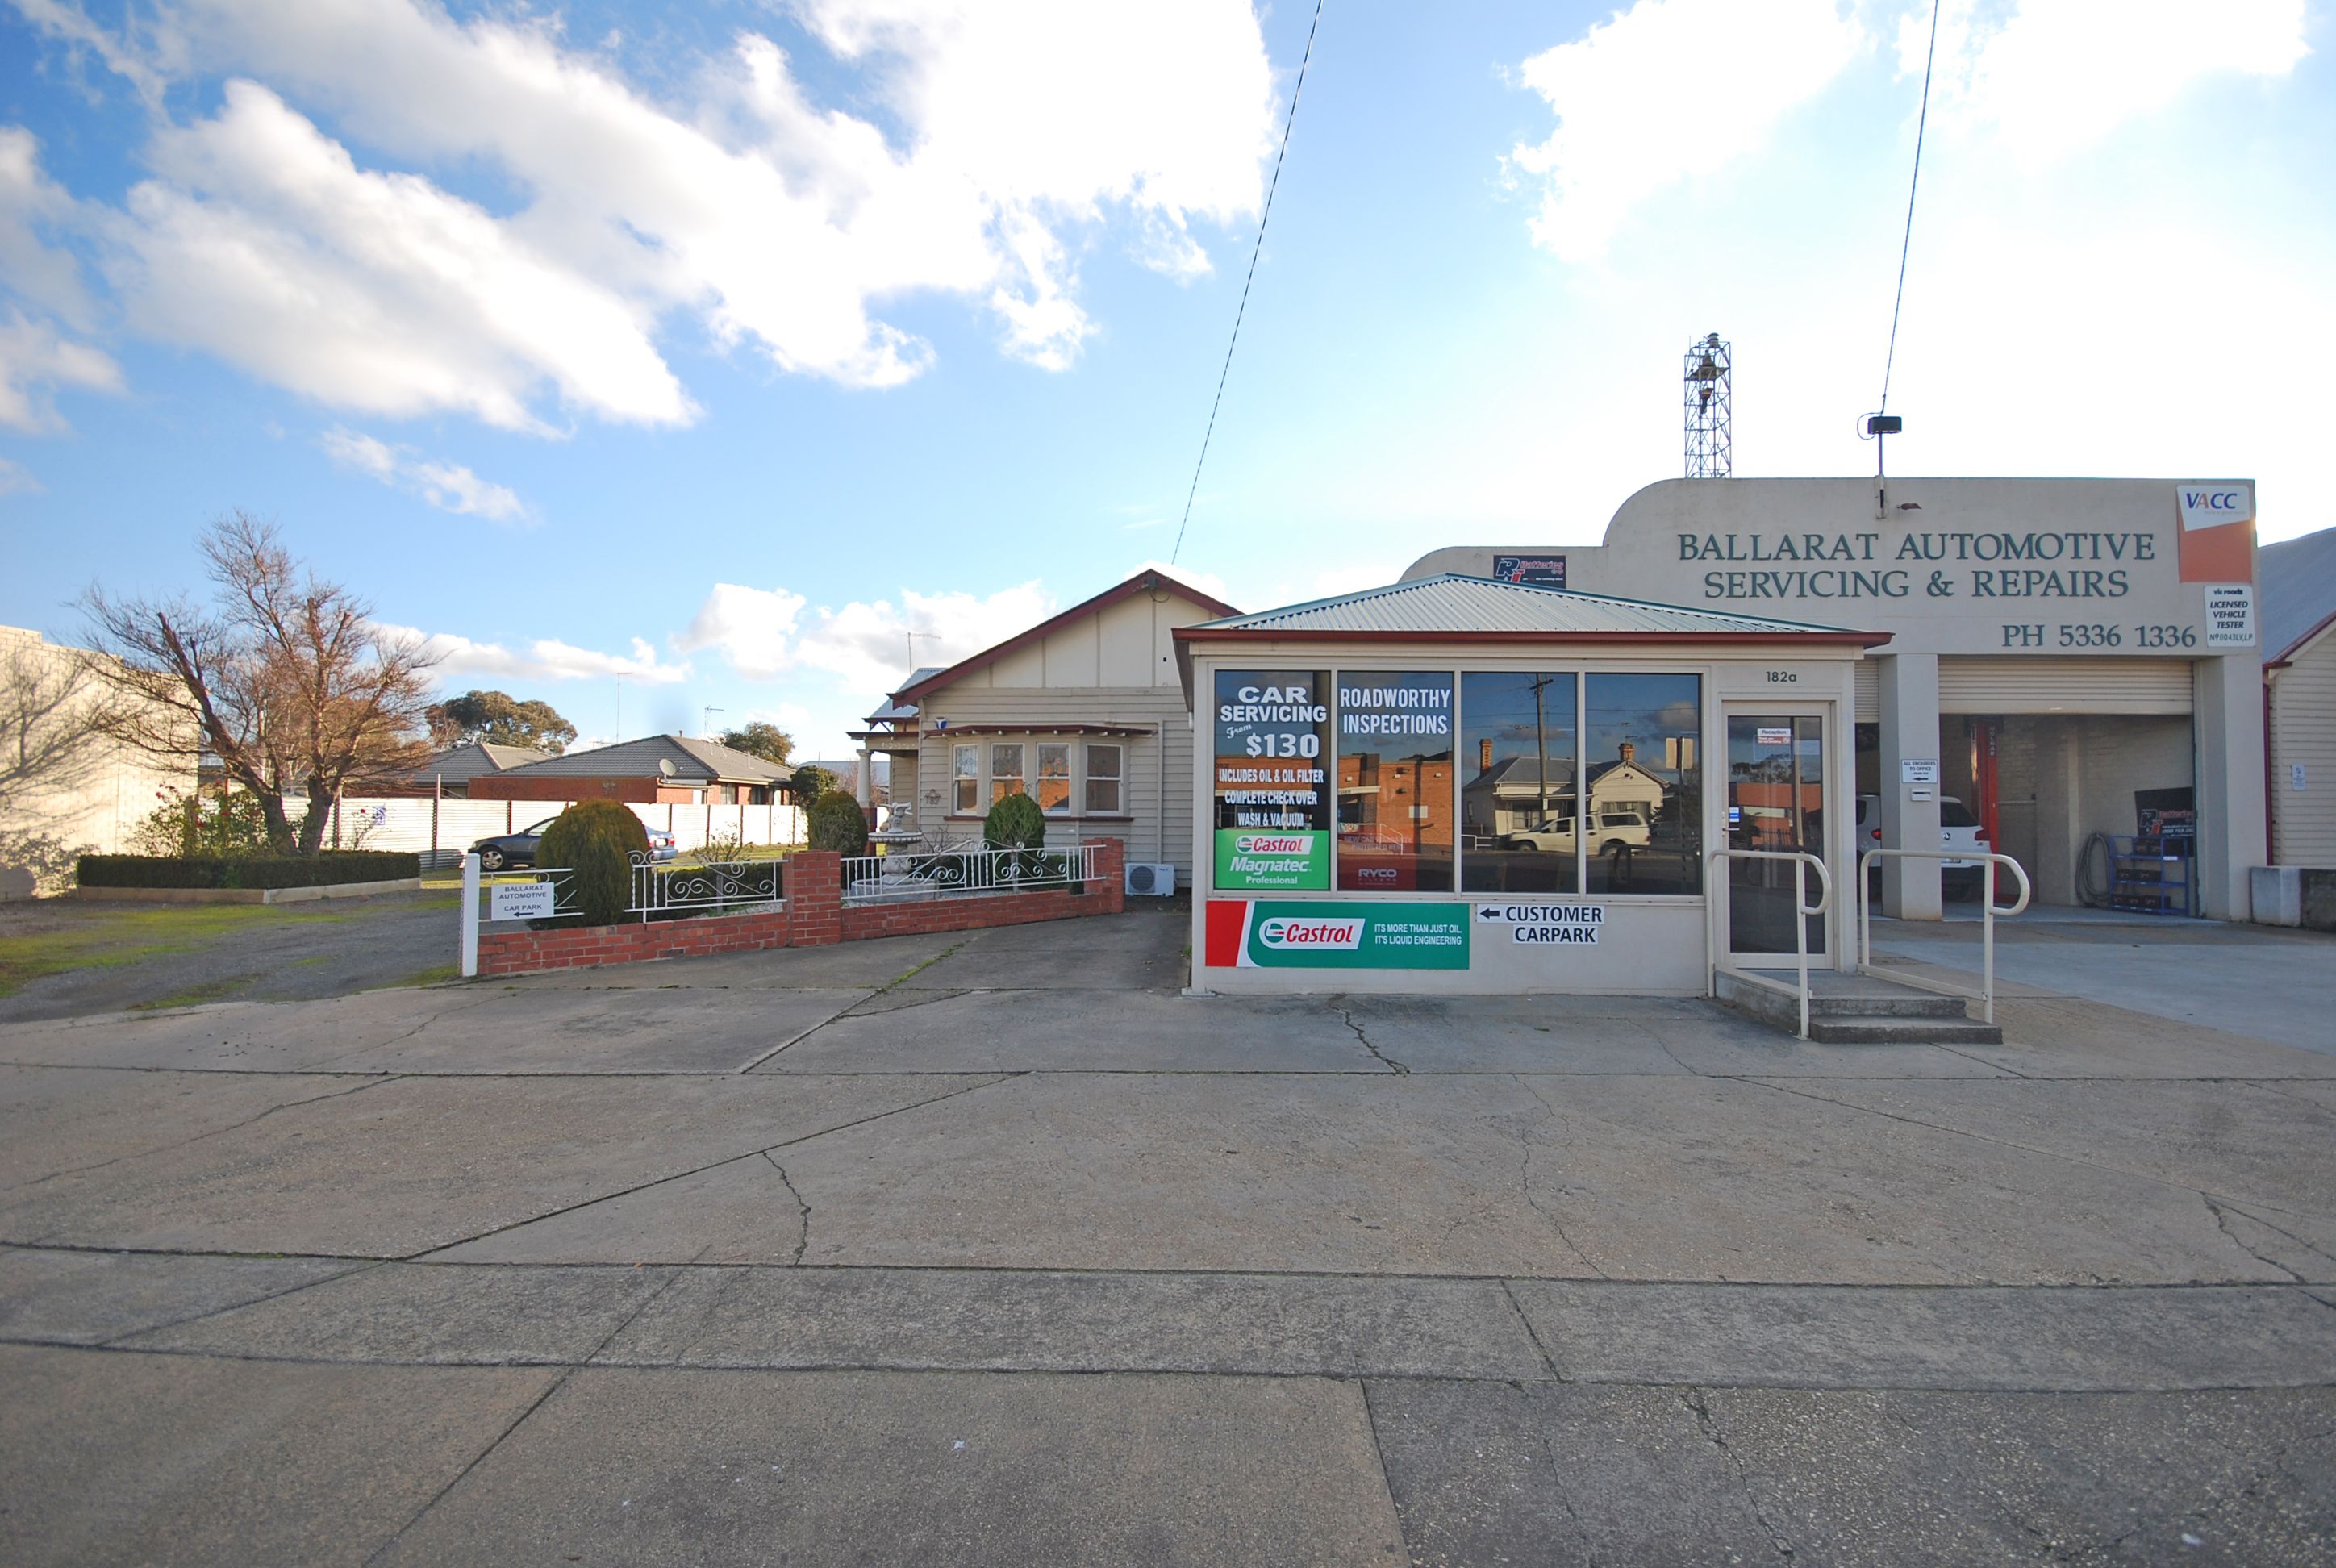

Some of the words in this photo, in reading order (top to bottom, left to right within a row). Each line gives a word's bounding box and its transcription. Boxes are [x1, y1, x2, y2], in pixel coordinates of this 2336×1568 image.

[2186, 493, 2238, 509] VACC
[1677, 533, 1879, 561] BALLARAT
[1895, 533, 2155, 561] AUTOMOTIVE
[1704, 570, 1909, 598] SERVICING
[1926, 570, 1954, 597] &
[1971, 570, 2130, 597] REPAIRS
[2213, 611, 2246, 619] VEHICLE
[2217, 621, 2244, 629] TESTER
[2002, 624, 2045, 646] PH
[2059, 624, 2121, 647] 5336
[2134, 624, 2196, 648] 1336
[1766, 671, 1797, 682] 182a
[1238, 686, 1308, 703] CAR
[1340, 688, 1451, 708] ROADWORTHY
[1220, 705, 1327, 722] SERVICING
[1226, 724, 1253, 739] From
[1343, 715, 1448, 734] INSPECTIONS
[1246, 732, 1320, 758] $130
[1219, 769, 1258, 782] INCLUDES
[1259, 769, 1272, 782] OIL
[1274, 769, 1280, 782] &
[1282, 769, 1295, 783] OIL
[1297, 769, 1324, 783] FILTER
[1224, 790, 1266, 804] COMPLETE
[1267, 791, 1295, 805] CHECK
[1295, 791, 1318, 805] OVER
[1237, 812, 1261, 827] WASH
[1262, 813, 1269, 827] &
[1270, 812, 1304, 827] VACUUM
[1253, 837, 1304, 852] Castrol
[1229, 857, 1310, 875] Magnatec
[1358, 869, 1398, 878] RYCO
[1245, 876, 1298, 884] Professional
[1506, 906, 1602, 923] CUSTOMER
[1286, 924, 1353, 943] Castrol
[1387, 924, 1408, 933] MORE
[1409, 924, 1429, 933] THAN
[1429, 924, 1448, 933] JUST
[1449, 924, 1462, 934] OIL.
[1515, 927, 1596, 942] CARPARK
[1389, 936, 1412, 945] LIQUID
[1414, 936, 1462, 945] ENGINEERING
